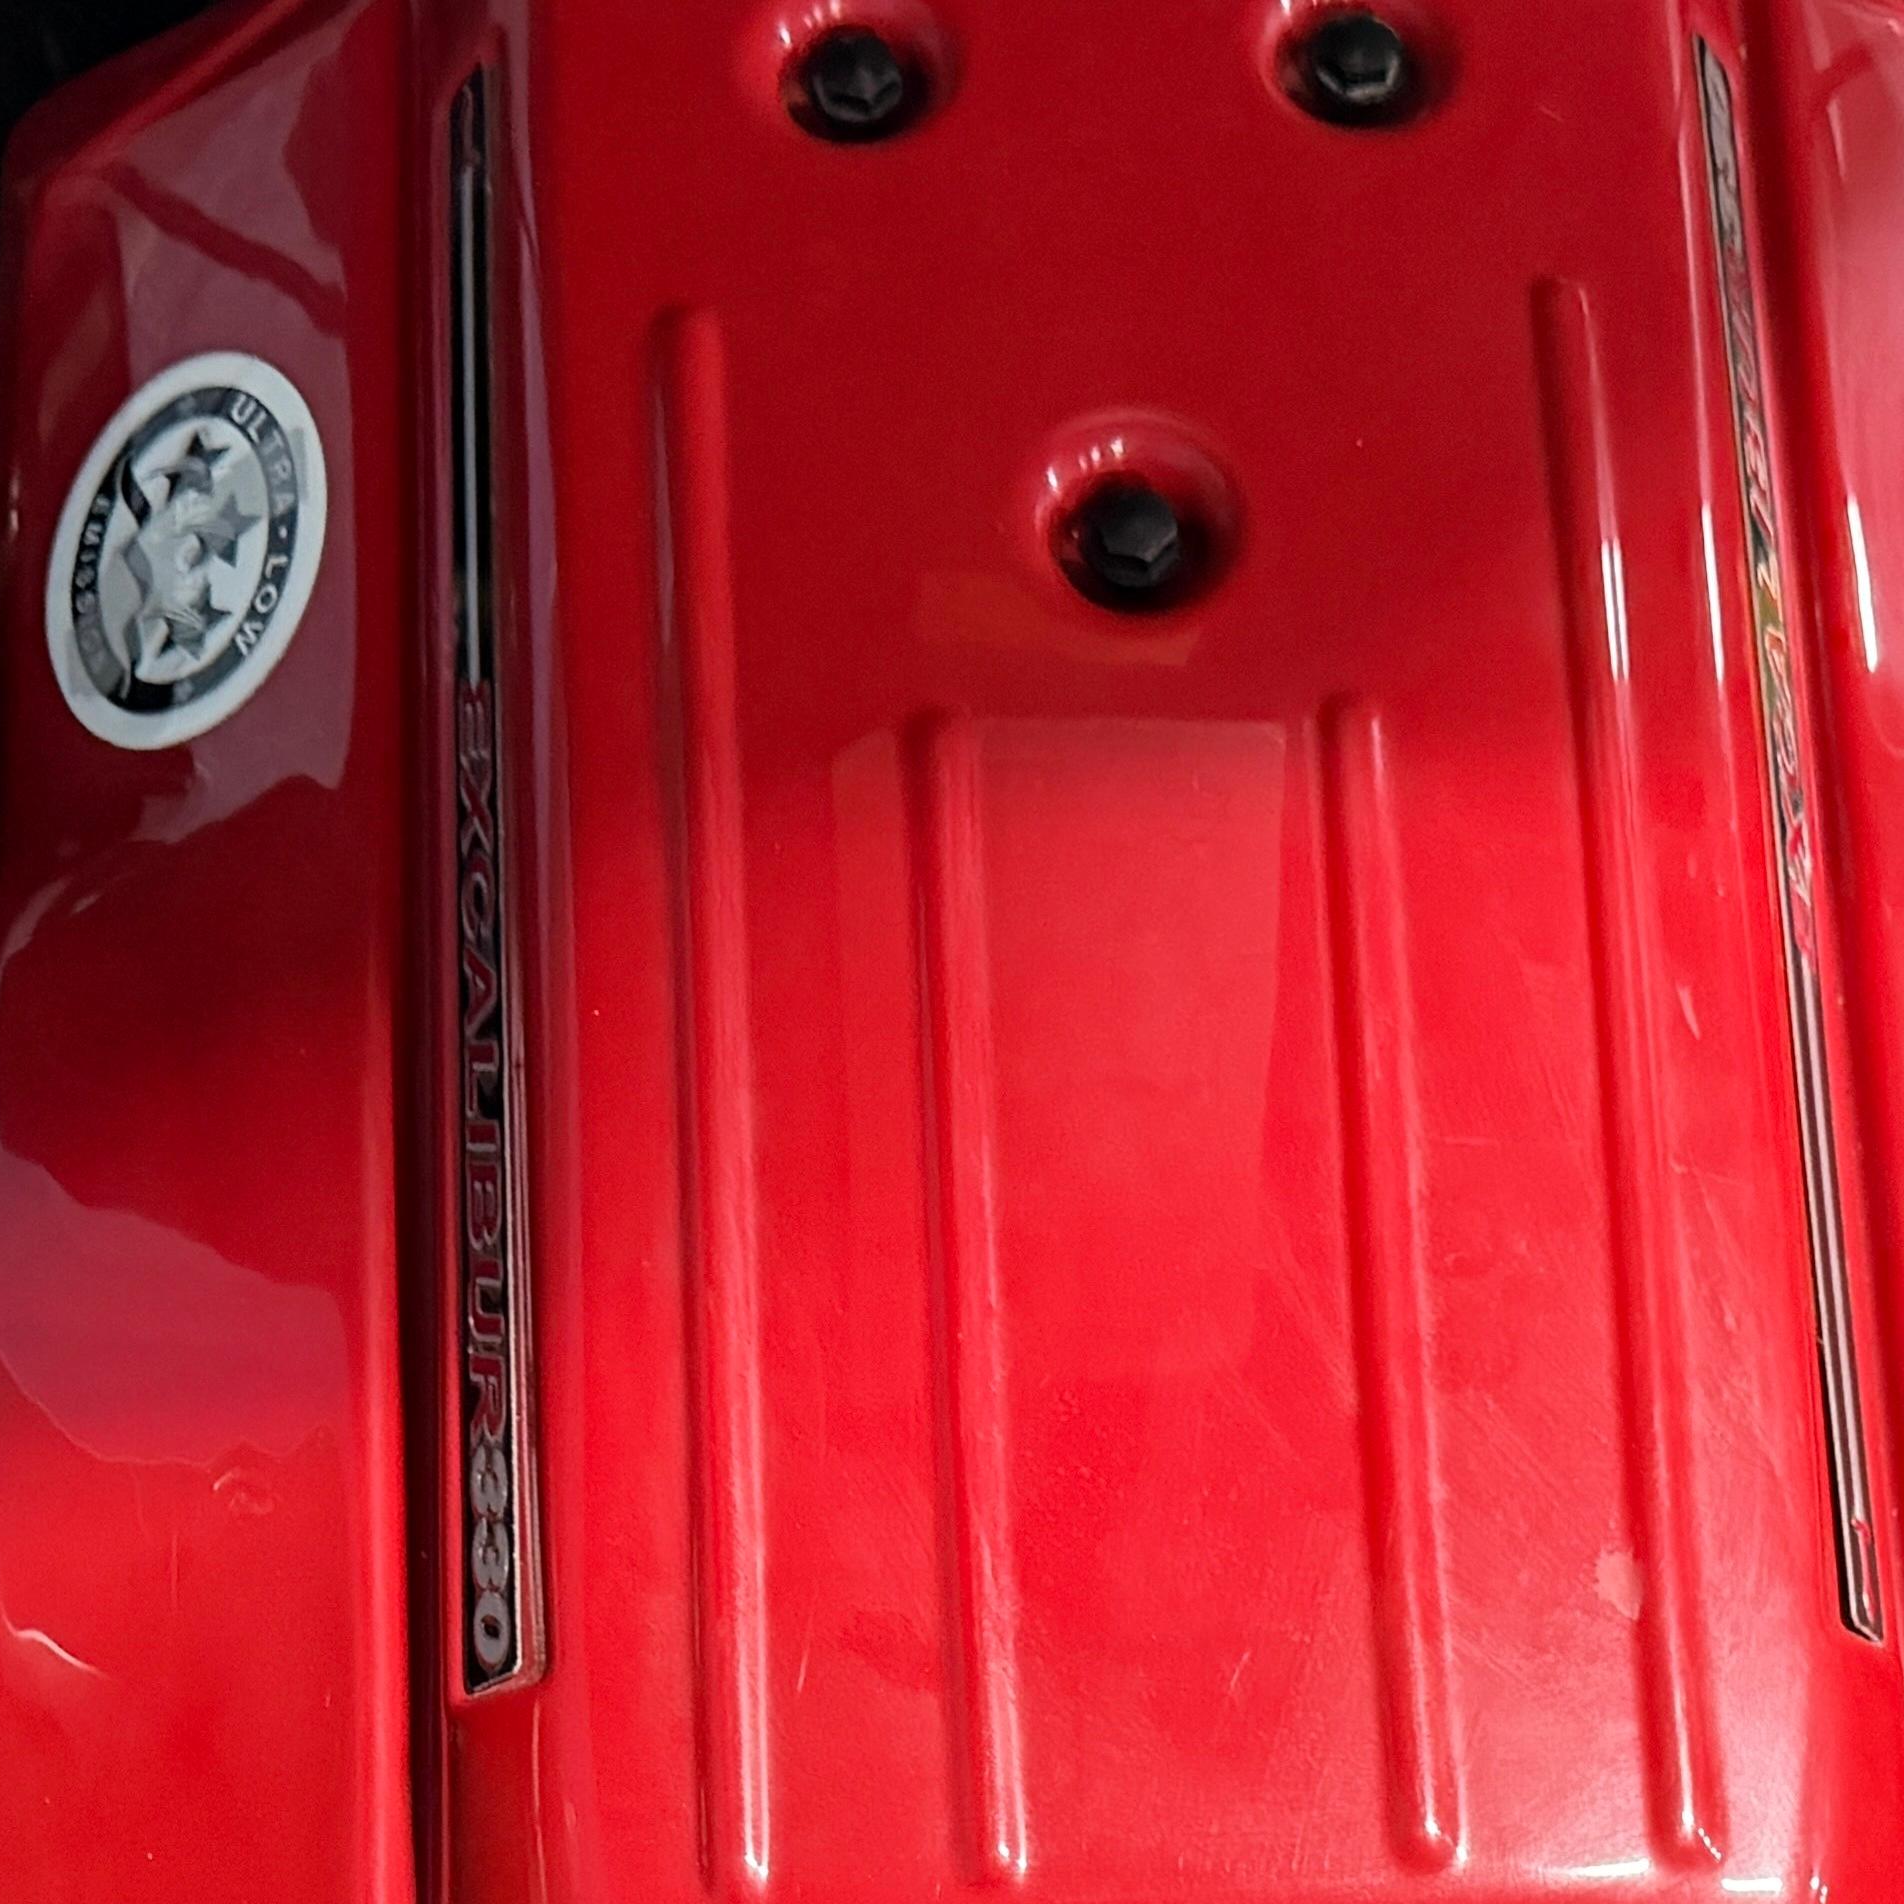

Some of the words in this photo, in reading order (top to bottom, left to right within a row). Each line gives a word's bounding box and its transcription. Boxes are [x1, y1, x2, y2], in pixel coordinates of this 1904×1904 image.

[231, 394, 295, 517] ULTRA
[233, 554, 289, 656] LOW
[459, 682, 508, 1444] EXCALIBUR
[470, 1442, 511, 1670] 330
